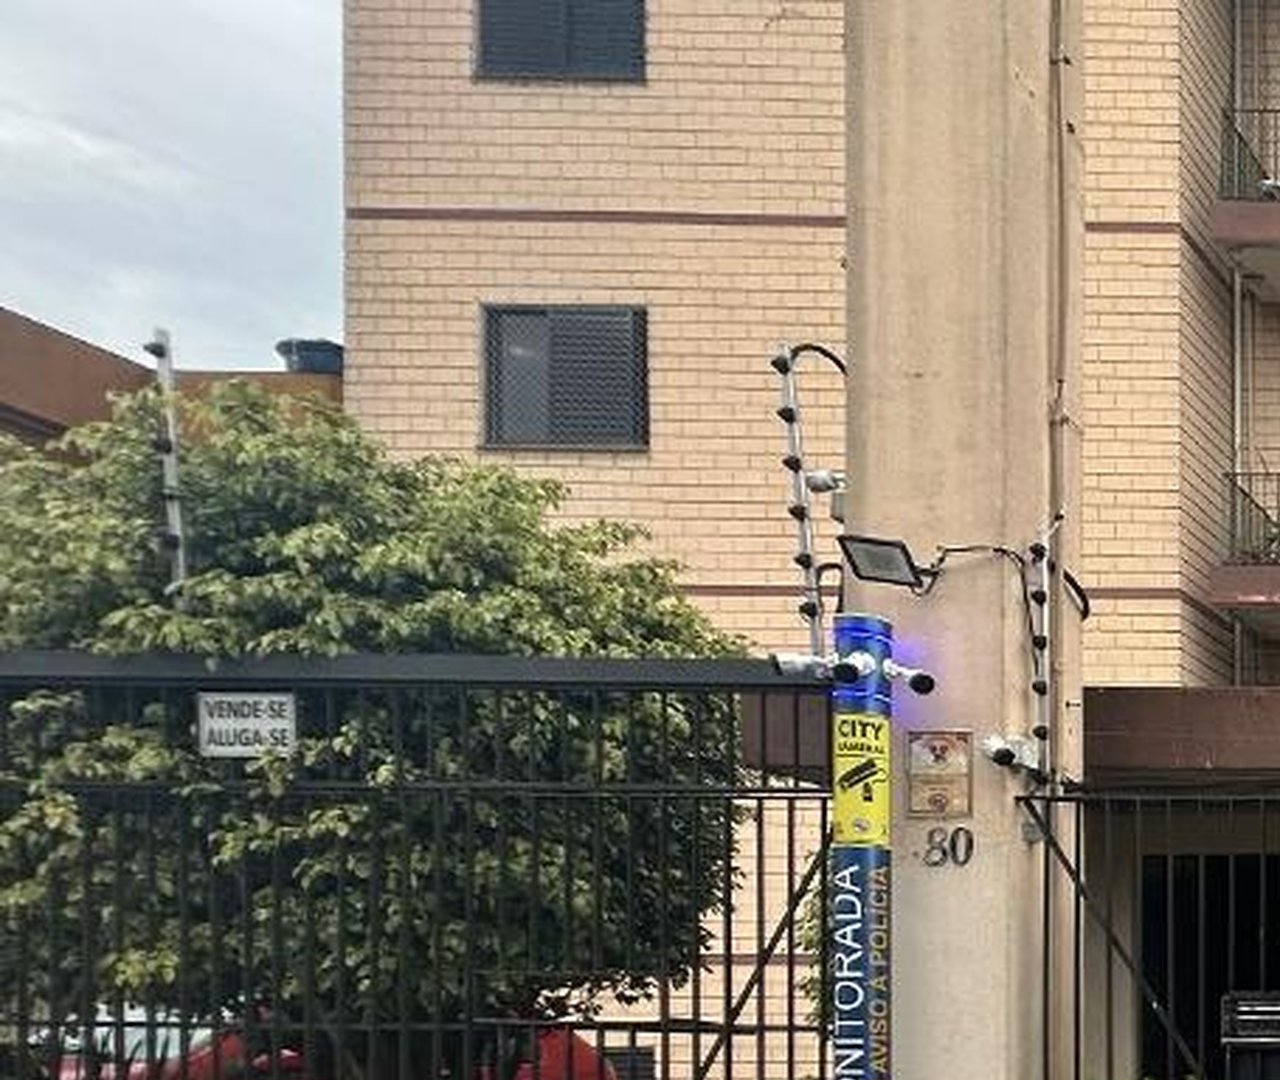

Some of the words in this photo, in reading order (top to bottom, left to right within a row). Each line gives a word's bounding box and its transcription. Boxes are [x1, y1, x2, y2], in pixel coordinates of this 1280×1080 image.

[205, 700, 287, 719] VENDE-SE
[206, 728, 289, 747] ALUGA-SE
[838, 719, 884, 741] CITY
[923, 826, 974, 867] 80
[868, 999, 888, 1074] AVISO
